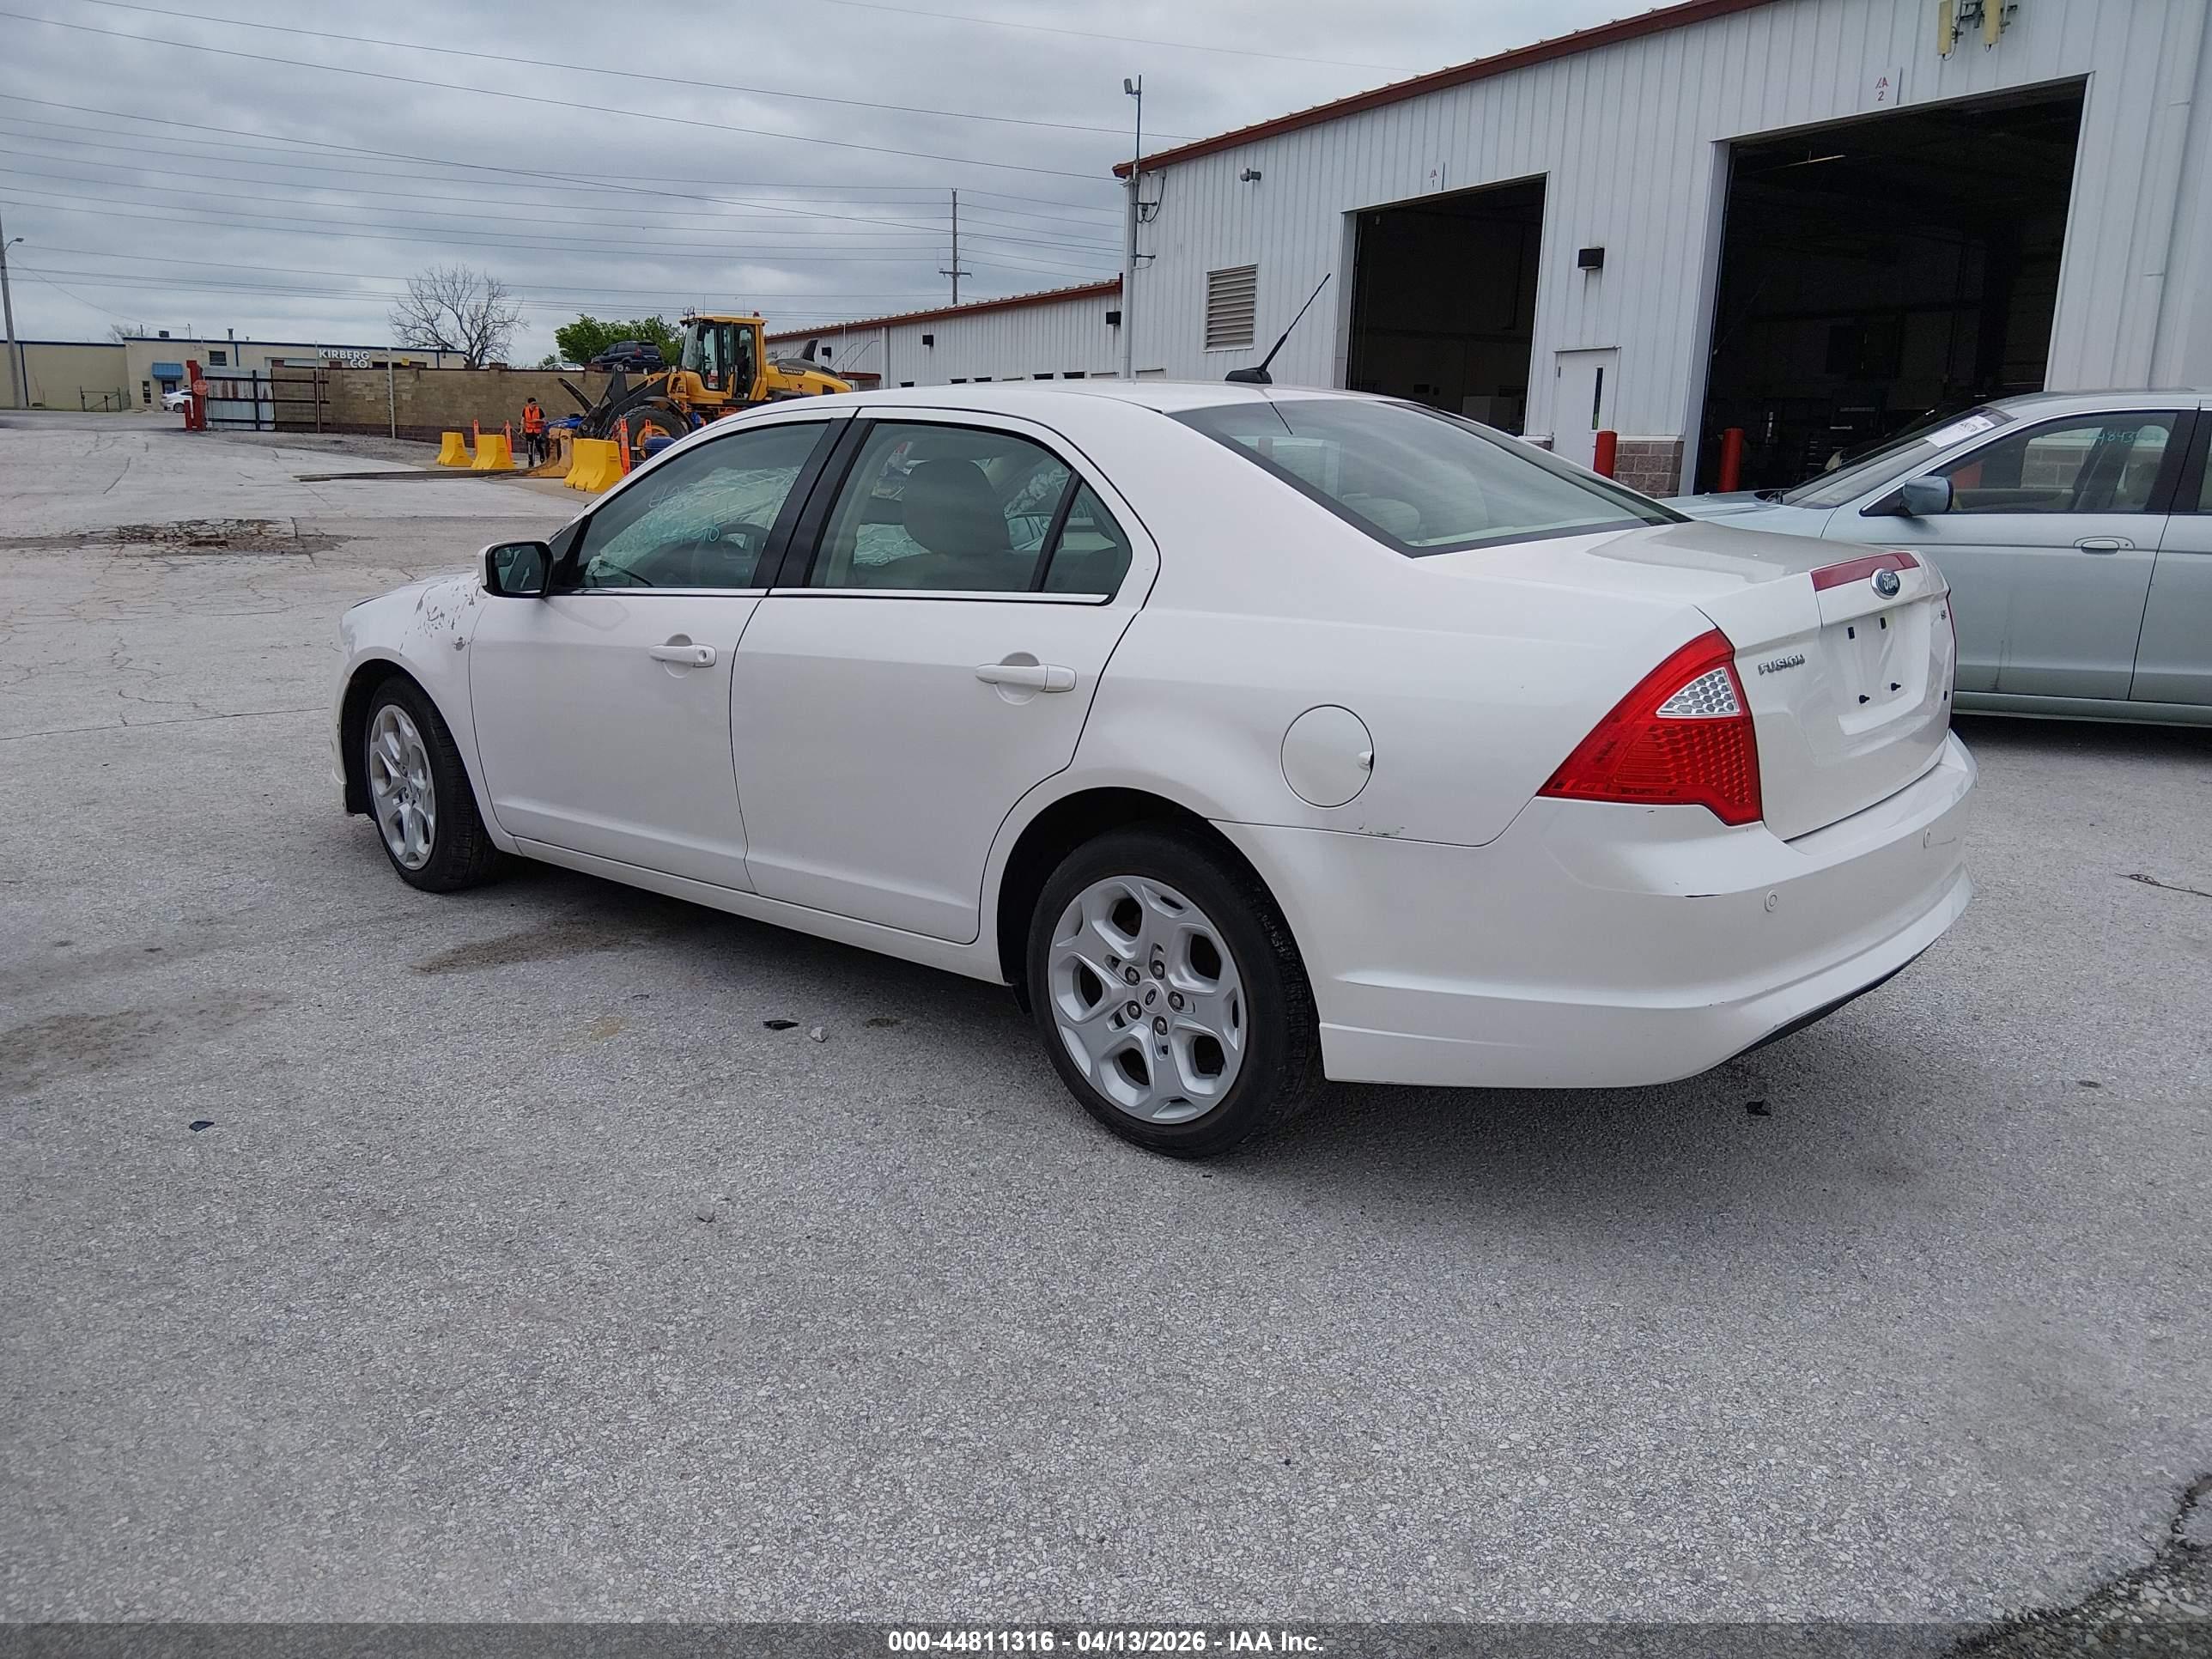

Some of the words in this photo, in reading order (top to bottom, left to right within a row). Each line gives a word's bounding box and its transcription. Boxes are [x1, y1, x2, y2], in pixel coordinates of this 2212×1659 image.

[1877, 90, 1885, 101] 2
[319, 349, 370, 360] KIRBERG
[1757, 653, 1806, 676] FUSION
